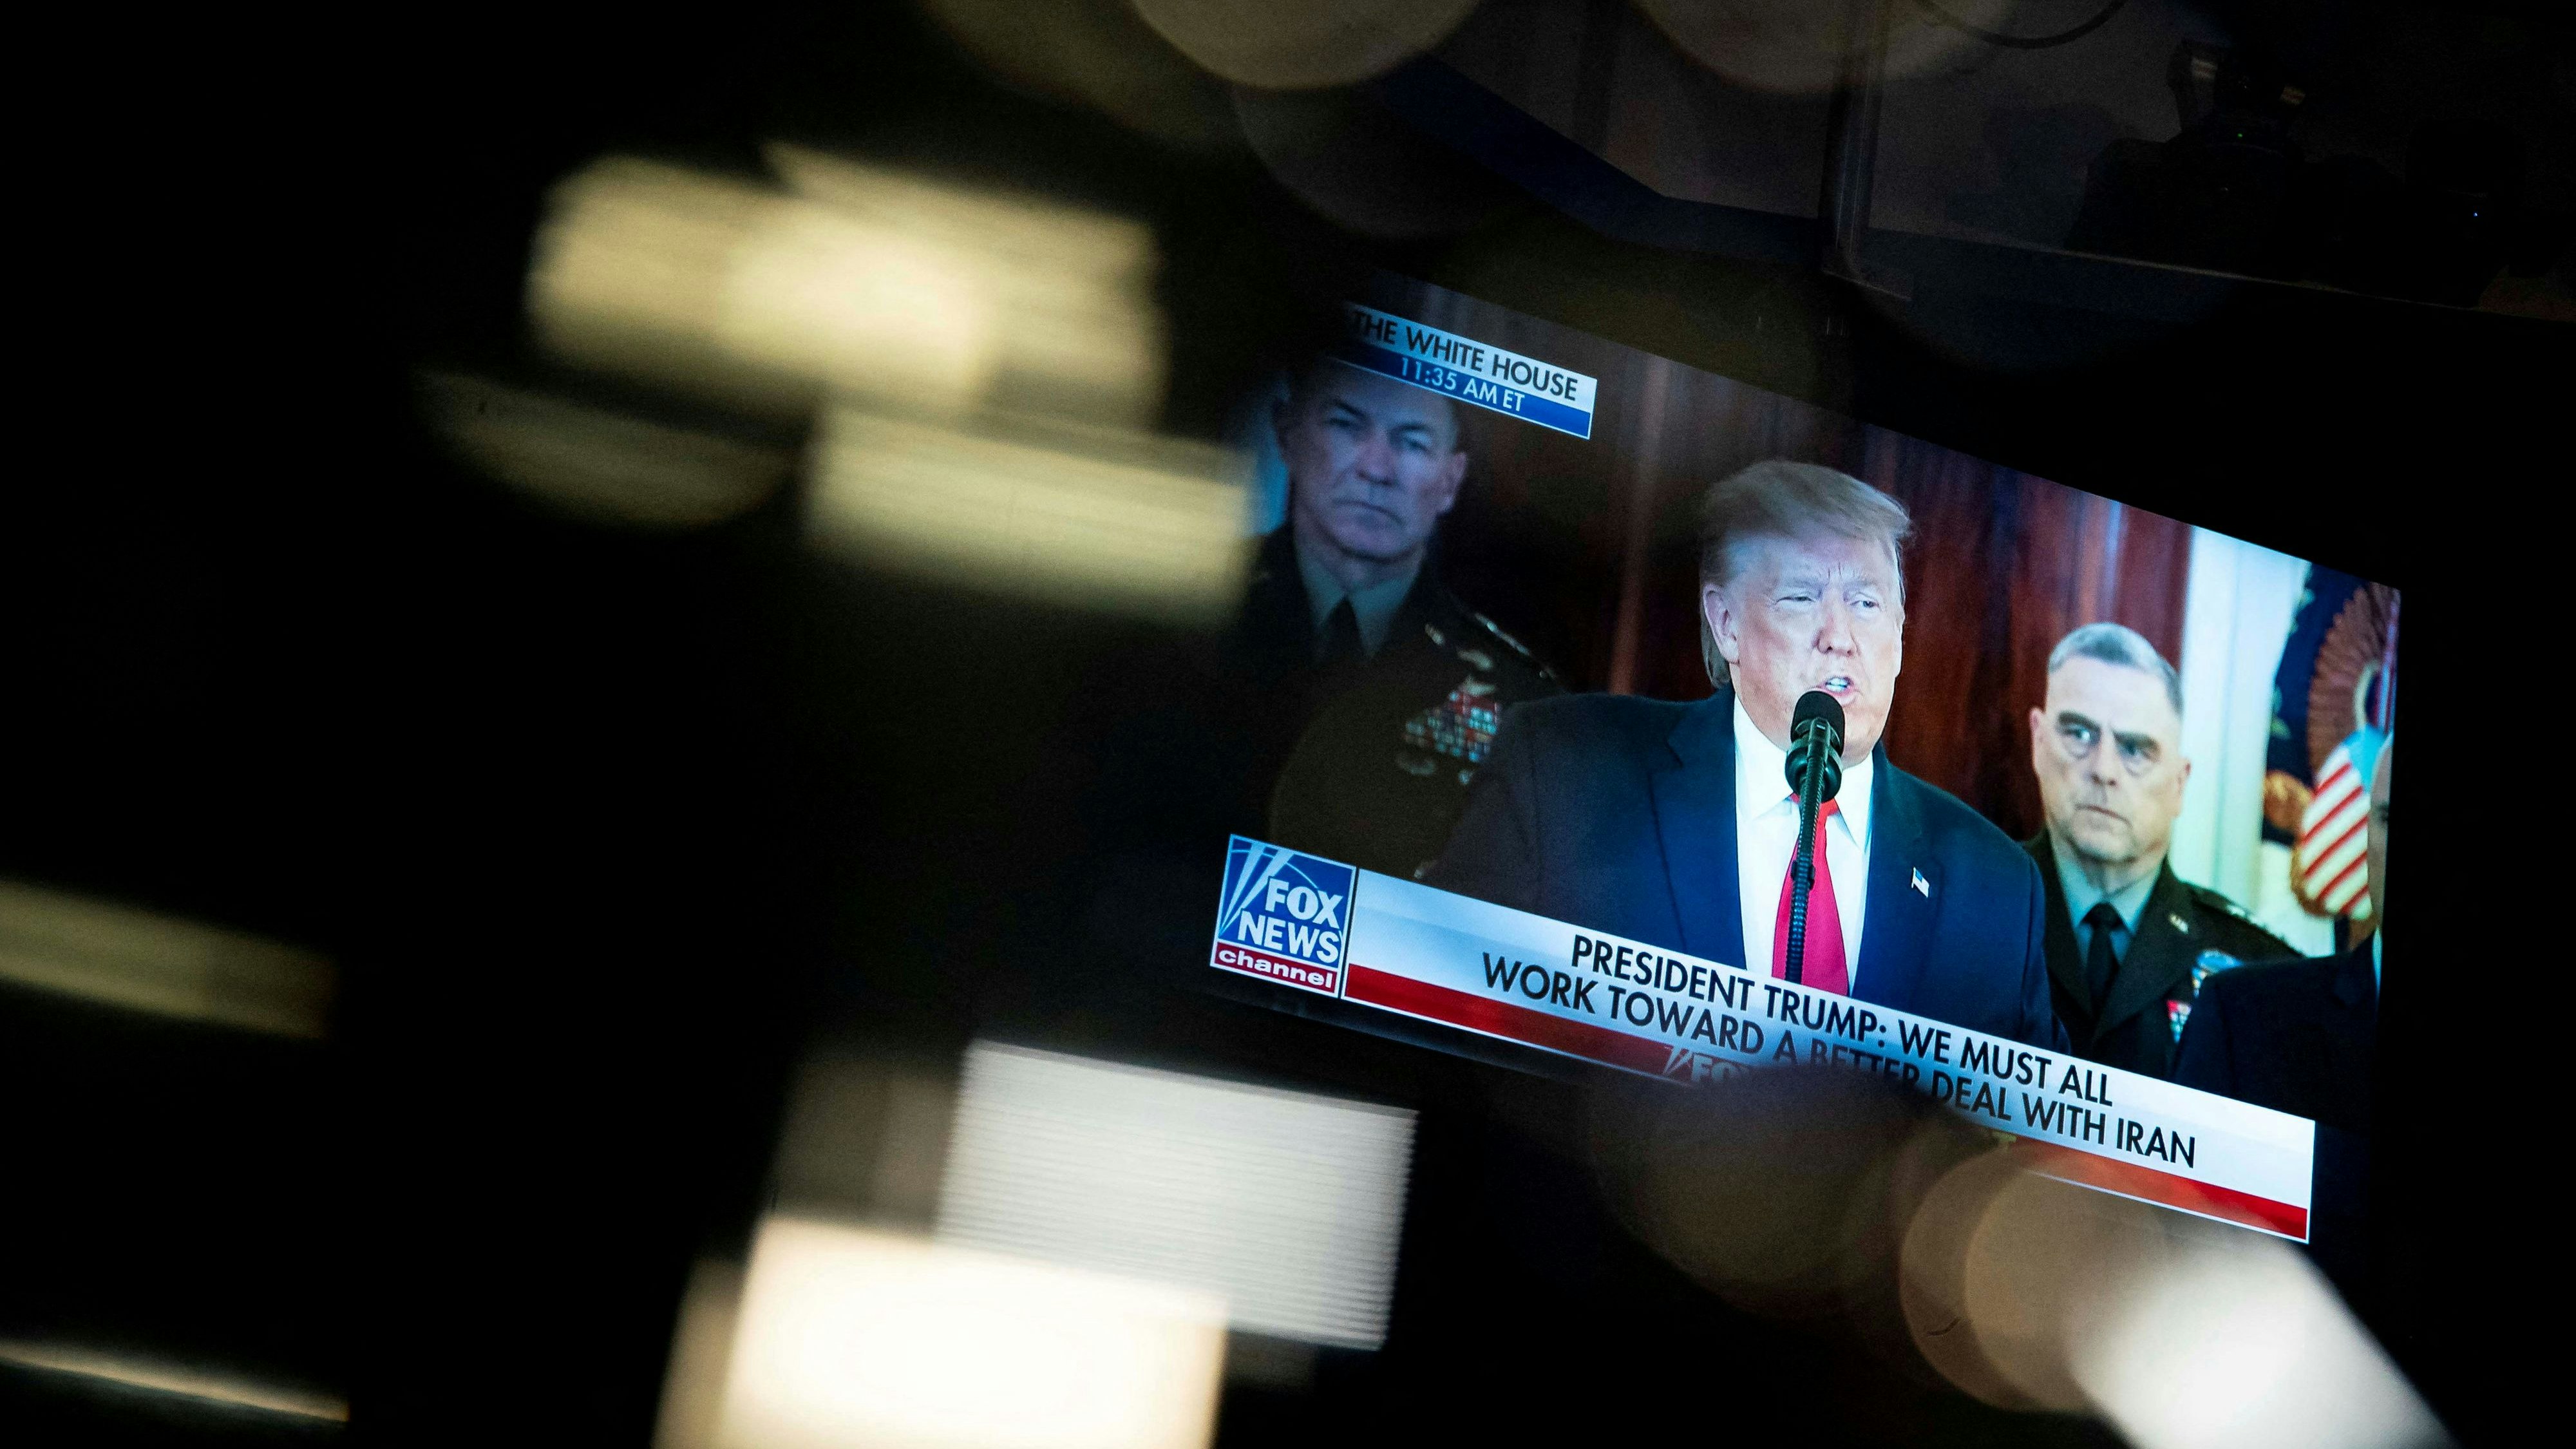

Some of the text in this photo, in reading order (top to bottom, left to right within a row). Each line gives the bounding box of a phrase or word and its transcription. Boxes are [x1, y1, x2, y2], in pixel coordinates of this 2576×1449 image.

[1354, 310, 1578, 401] THE WHITE HOUSE
[1401, 357, 1525, 412] 11:35 AM ET
[1265, 877, 1343, 929] FOX
[1237, 910, 1340, 963] NEWS
[1218, 949, 1333, 989] channel
[1571, 934, 2113, 1107] PRESIDENT TRUMP: WE MUST ALL
[1482, 952, 1598, 1014] WORK
[1608, 985, 1765, 1054] TOWARD
[1772, 1030, 1798, 1065] A
[1932, 1070, 2012, 1121] DEAL
[2021, 1092, 2107, 1145] WITH
[2116, 1117, 2196, 1170] IRAN
